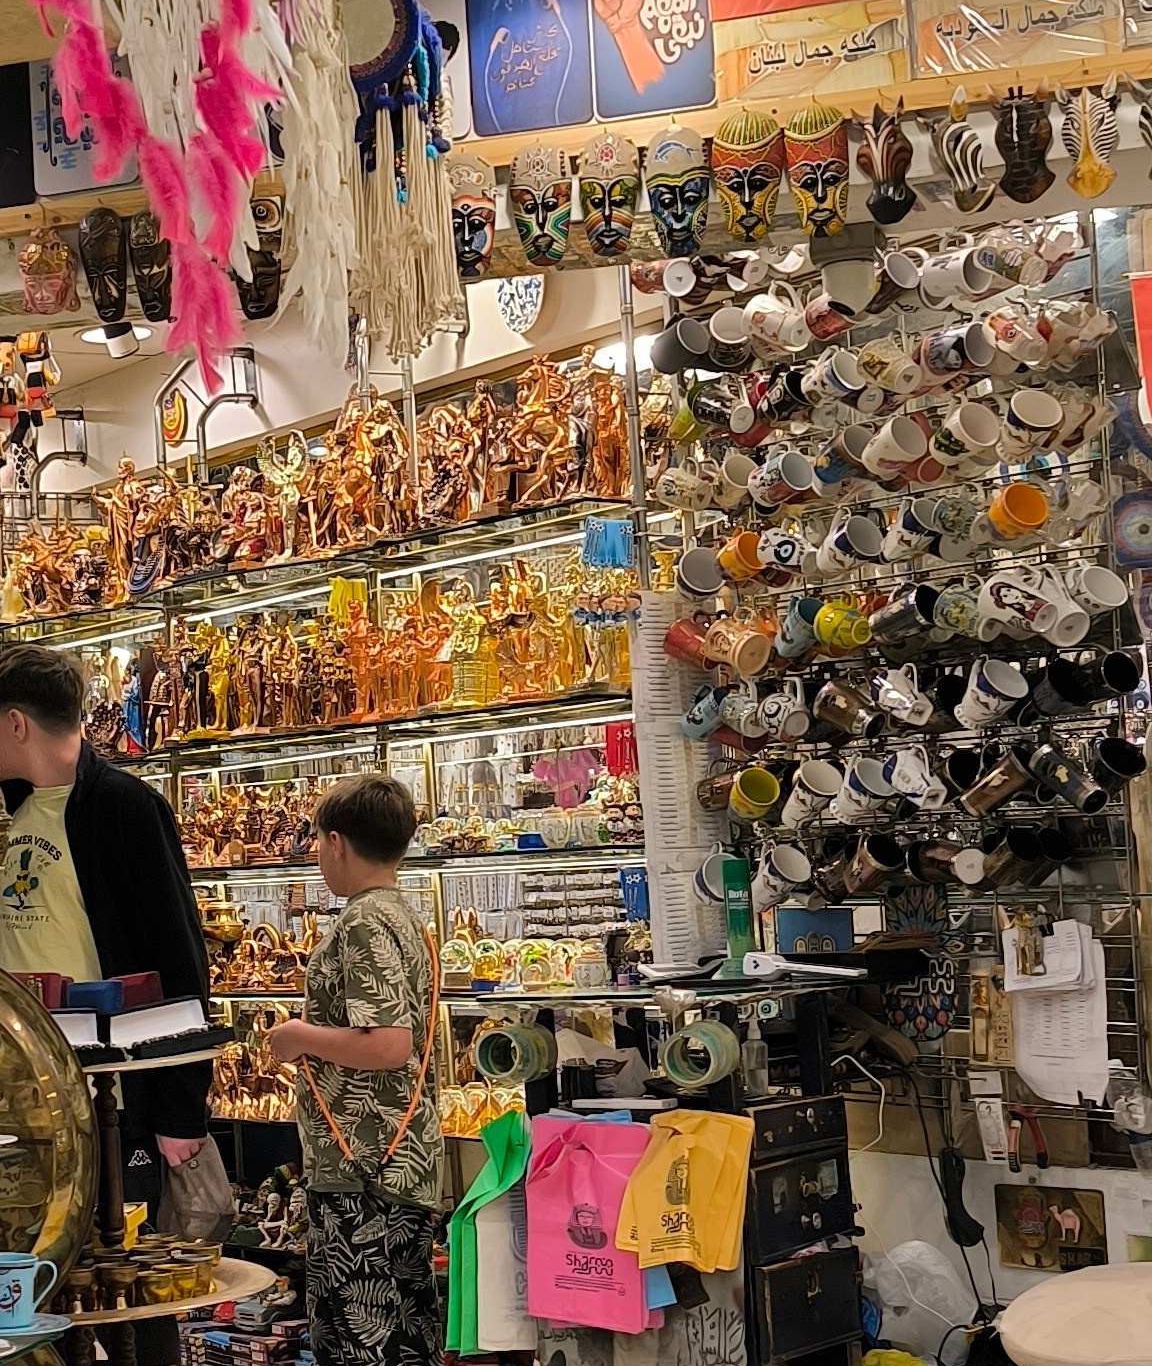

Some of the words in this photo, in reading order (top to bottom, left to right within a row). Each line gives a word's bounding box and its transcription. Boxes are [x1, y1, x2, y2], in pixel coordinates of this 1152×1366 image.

[1017, 3, 1061, 34] جمال
[792, 39, 834, 67] جمال
[839, 29, 877, 55] ملكه
[748, 41, 788, 75] لبنان
[35, 835, 63, 861] VIBES
[26, 914, 51, 923] STATE
